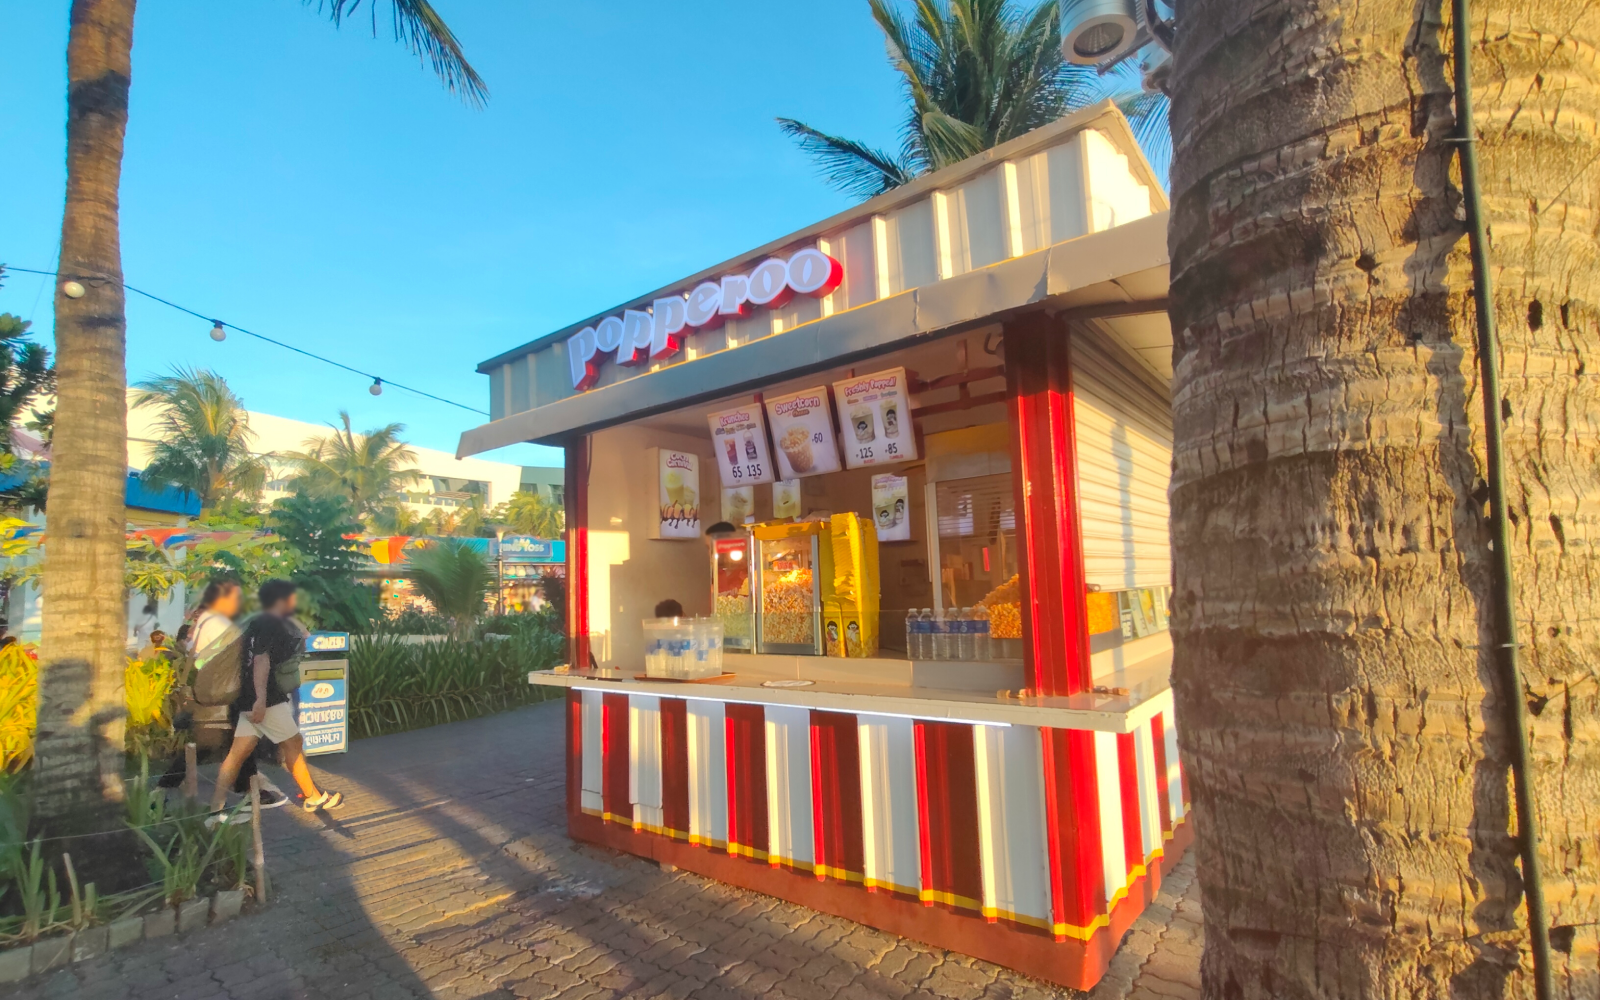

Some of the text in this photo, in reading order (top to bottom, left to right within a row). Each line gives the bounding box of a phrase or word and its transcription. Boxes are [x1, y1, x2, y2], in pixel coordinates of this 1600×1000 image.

[567, 248, 838, 391] popperoo
[844, 380, 870, 397] Freshly
[775, 396, 820, 416] Sweetcorn
[719, 411, 750, 428] Krunchee
[732, 463, 762, 479] 65 135
